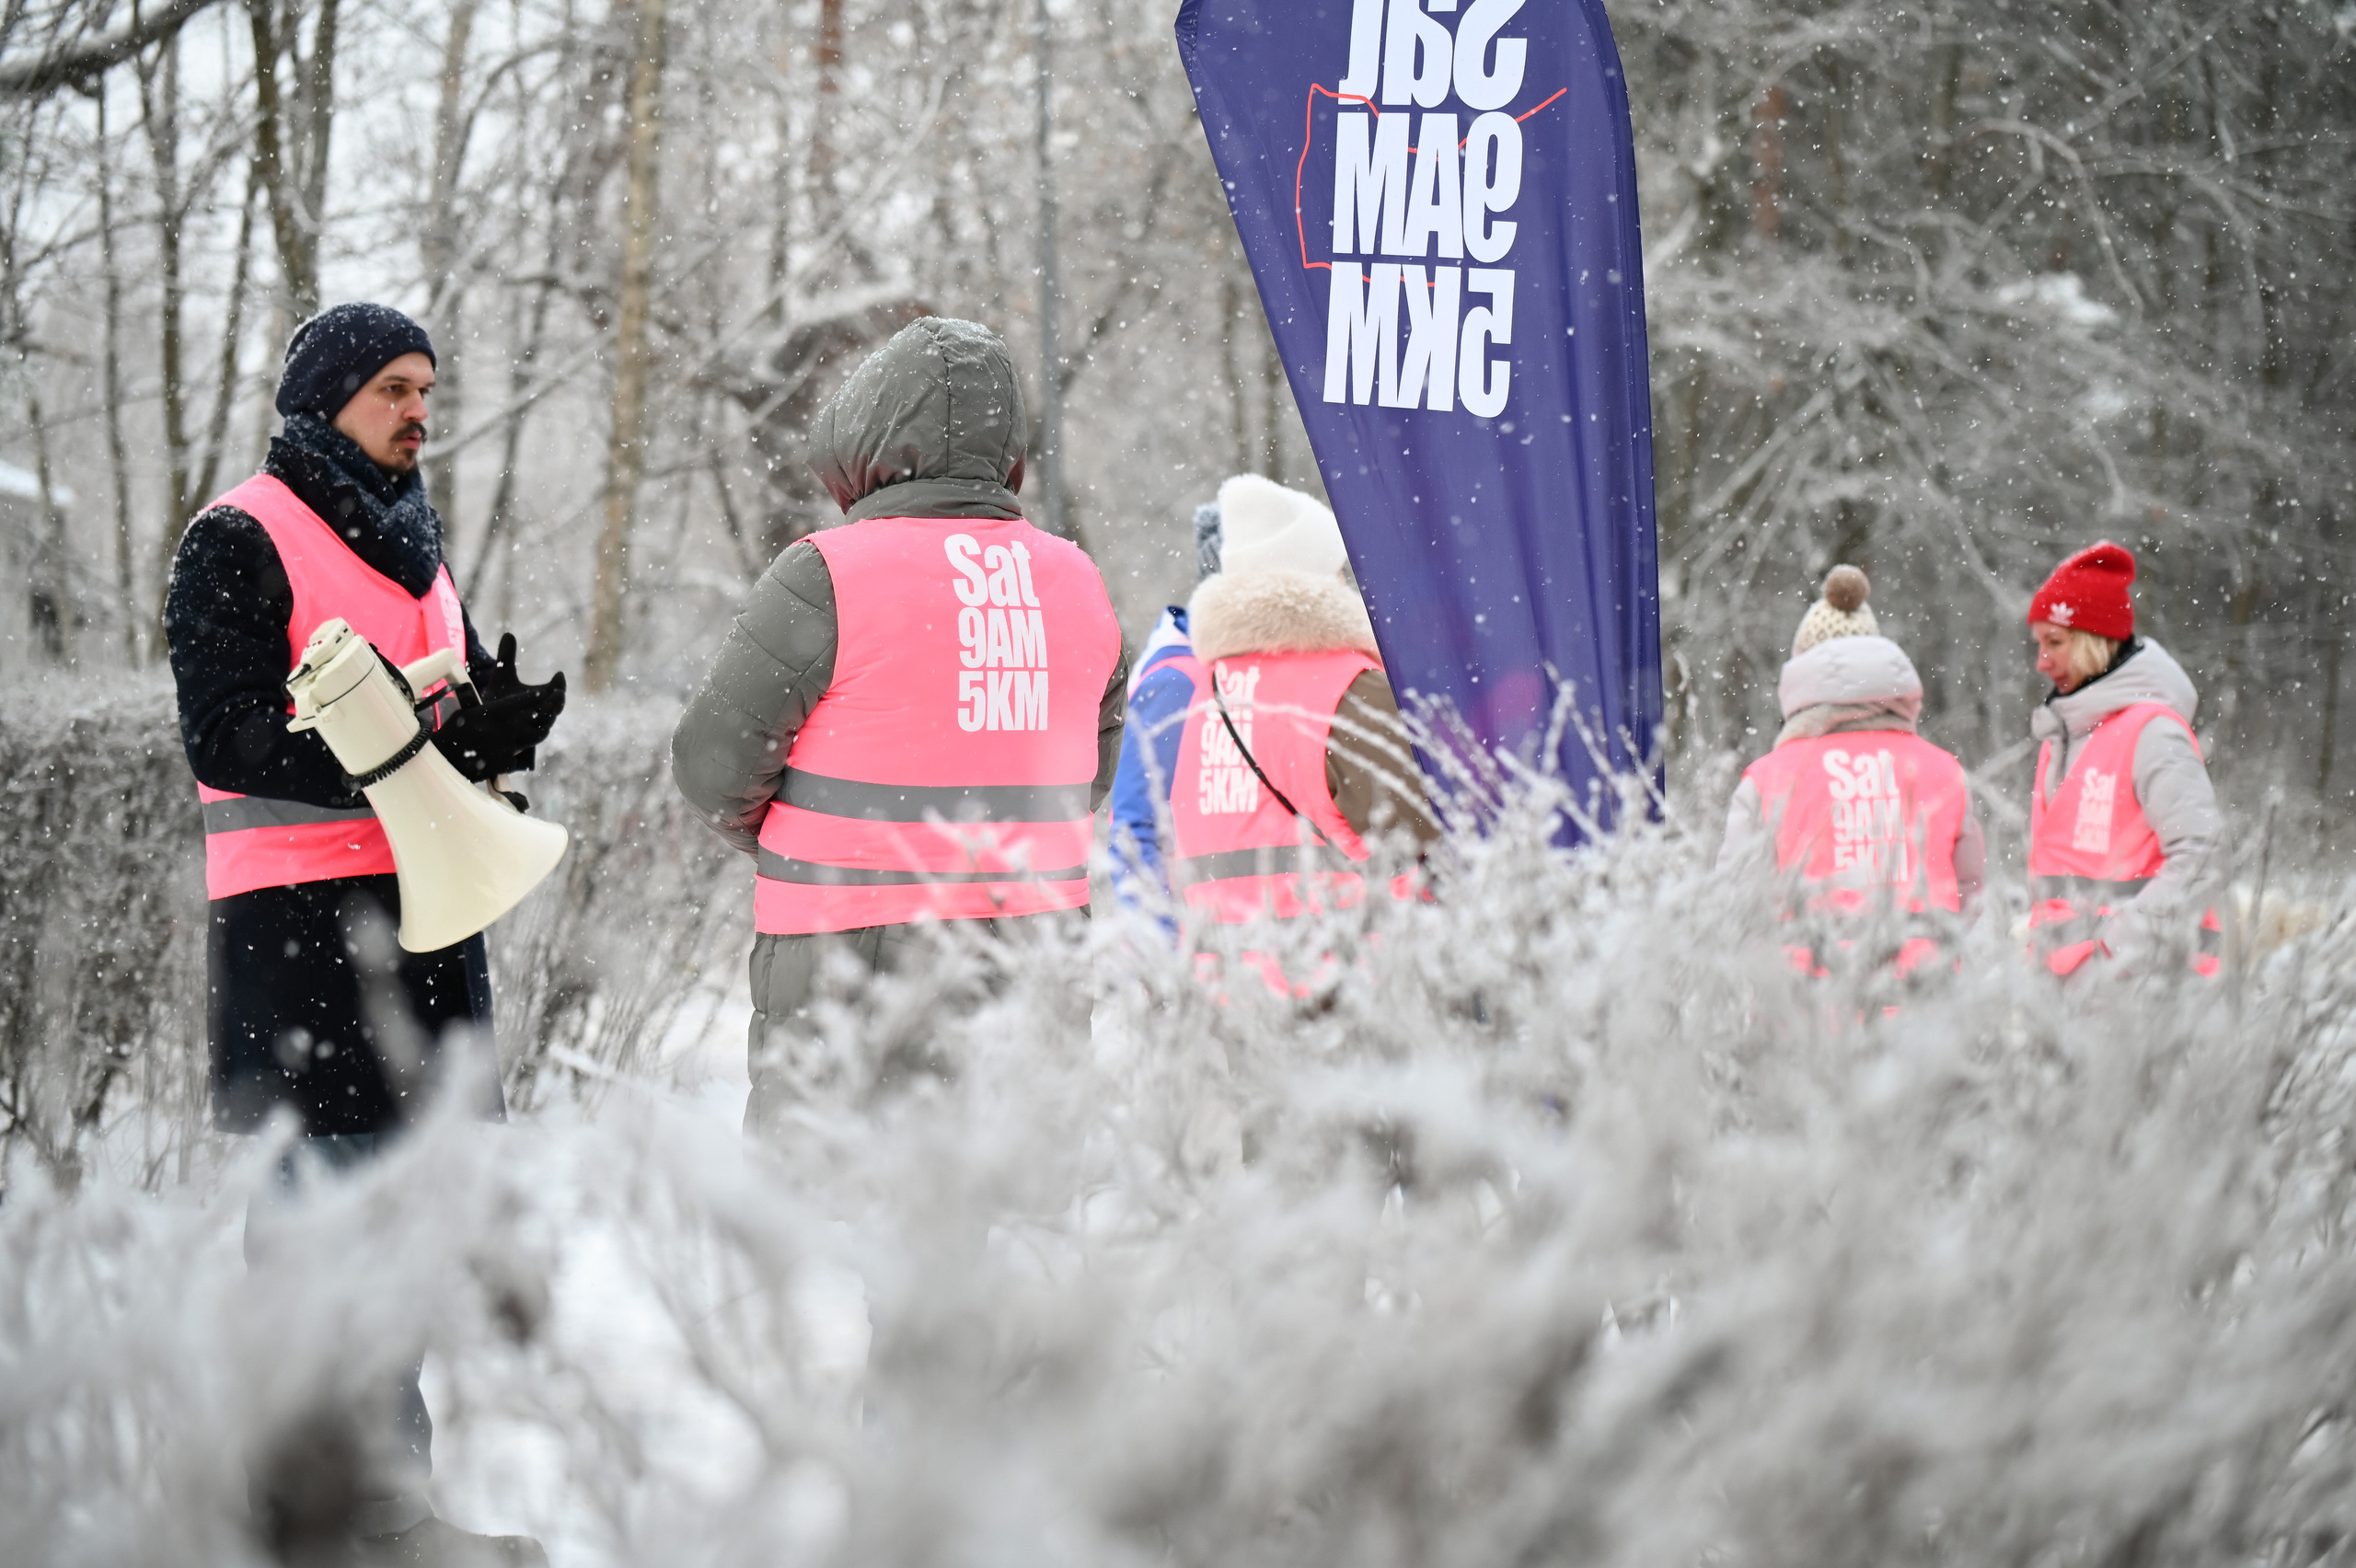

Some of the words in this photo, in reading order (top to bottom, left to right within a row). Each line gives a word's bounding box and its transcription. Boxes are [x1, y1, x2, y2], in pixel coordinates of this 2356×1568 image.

[944, 534, 1040, 607] Sat
[958, 607, 1047, 668] 9AM
[958, 671, 1048, 732] 5KM
[1199, 767, 1259, 815] 5KM
[1822, 748, 1900, 801] Sat
[1831, 798, 1905, 844] 9AM
